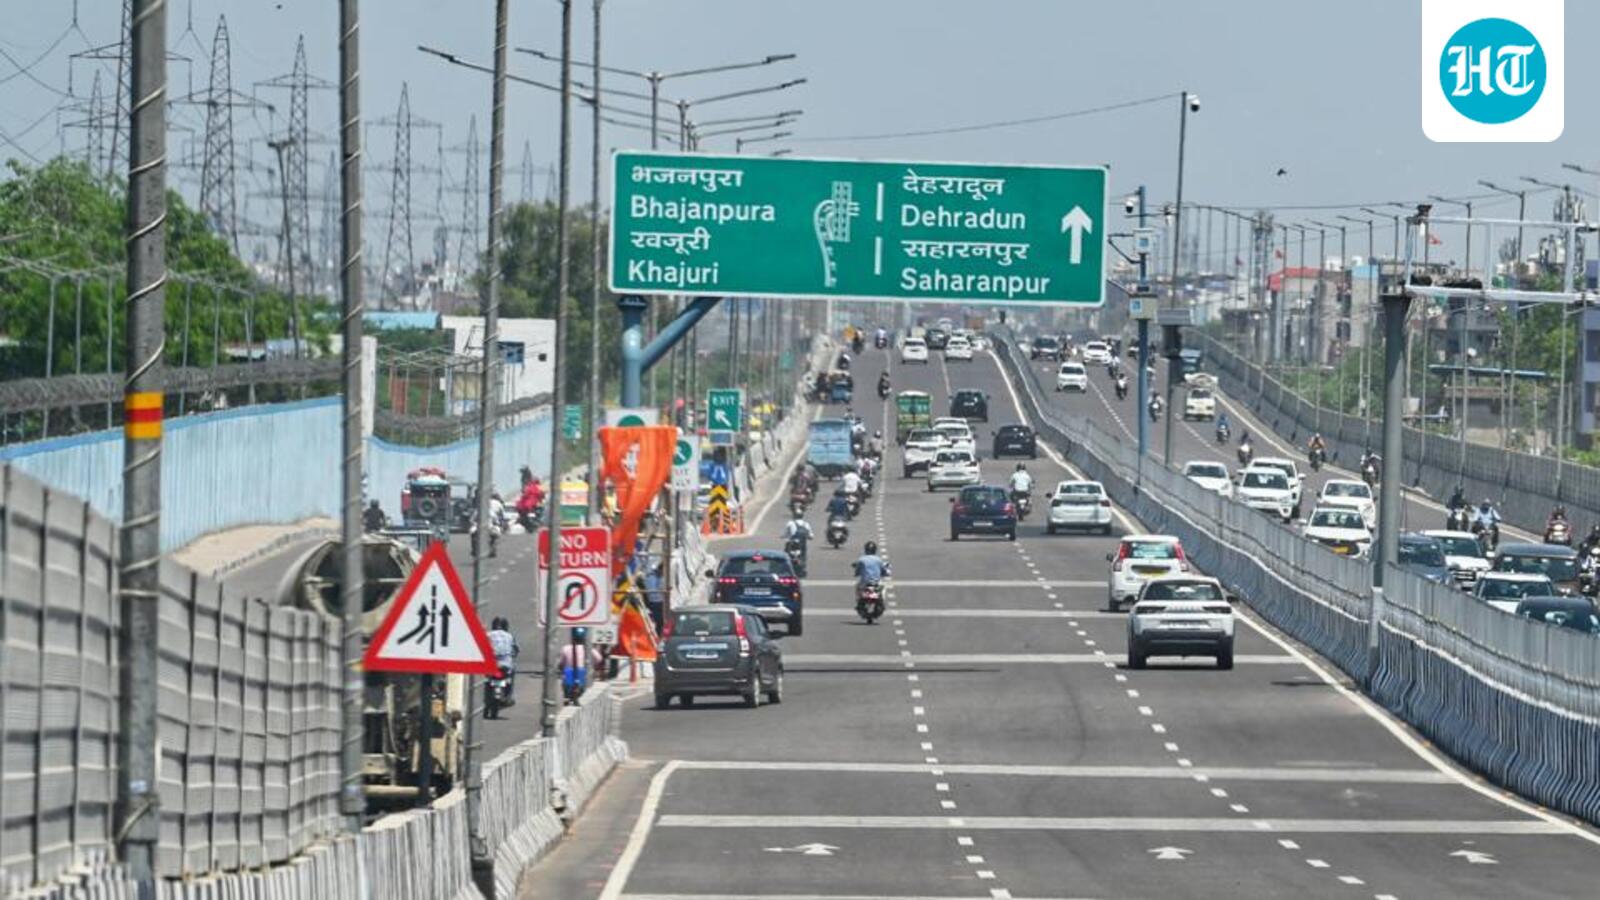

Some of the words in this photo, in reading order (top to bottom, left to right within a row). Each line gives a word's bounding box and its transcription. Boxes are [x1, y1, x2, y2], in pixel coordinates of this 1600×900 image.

[631, 166, 744, 192] भजनपुरा
[903, 168, 1006, 201] देहरादून
[631, 195, 775, 224] Bhajanpura
[901, 204, 1026, 229] Dehradun
[901, 240, 1030, 266] सहारनपुर
[628, 259, 719, 287] Khajuri
[901, 267, 1050, 298] Saharanpur
[712, 395, 735, 406] EXIT
[559, 534, 587, 549] NO
